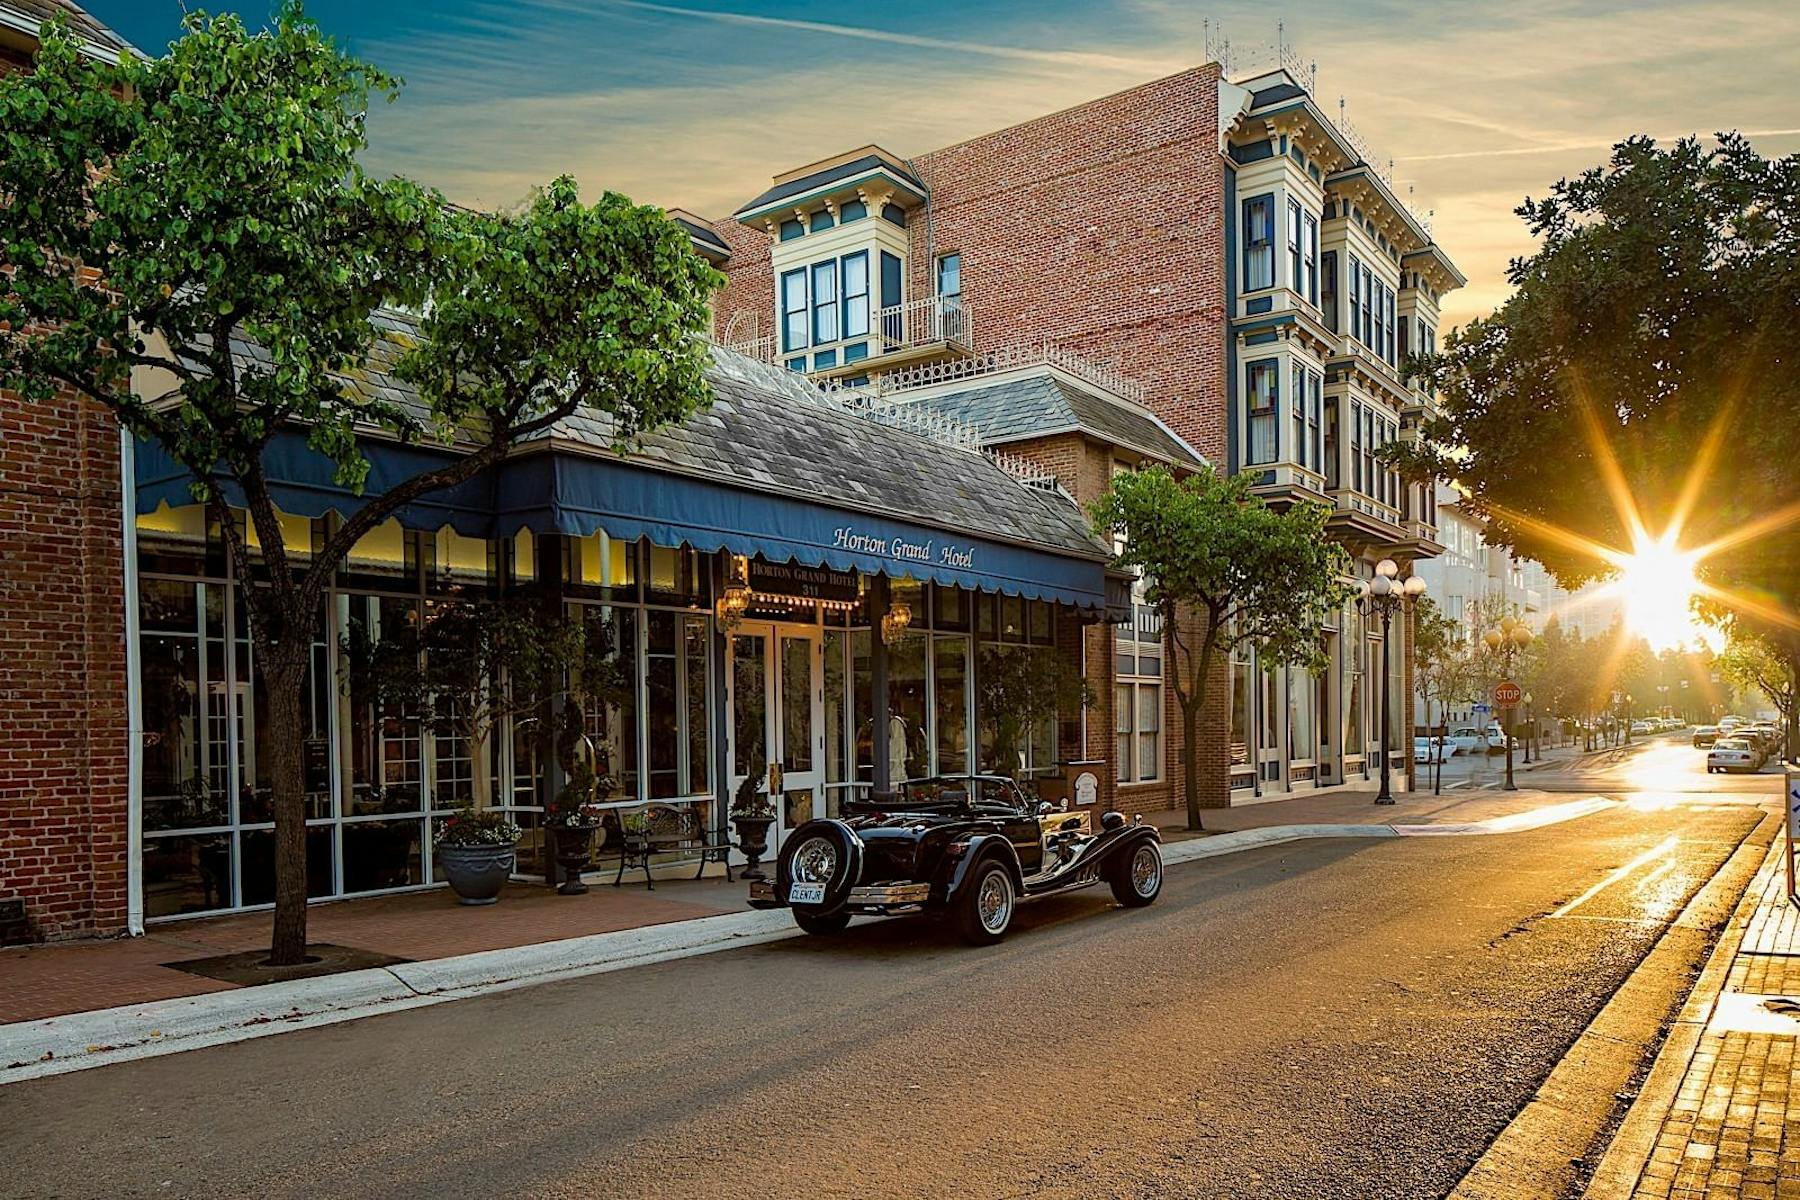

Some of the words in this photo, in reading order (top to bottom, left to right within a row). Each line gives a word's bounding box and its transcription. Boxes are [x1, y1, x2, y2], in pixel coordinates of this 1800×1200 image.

[833, 527, 887, 553] Horton
[891, 538, 932, 561] Grand
[939, 545, 975, 568] Hotel
[752, 562, 791, 580] HORTON
[793, 568, 827, 583] GRAND
[829, 572, 857, 587] HOTEL
[802, 584, 819, 596] 311
[1496, 689, 1520, 700] STOP
